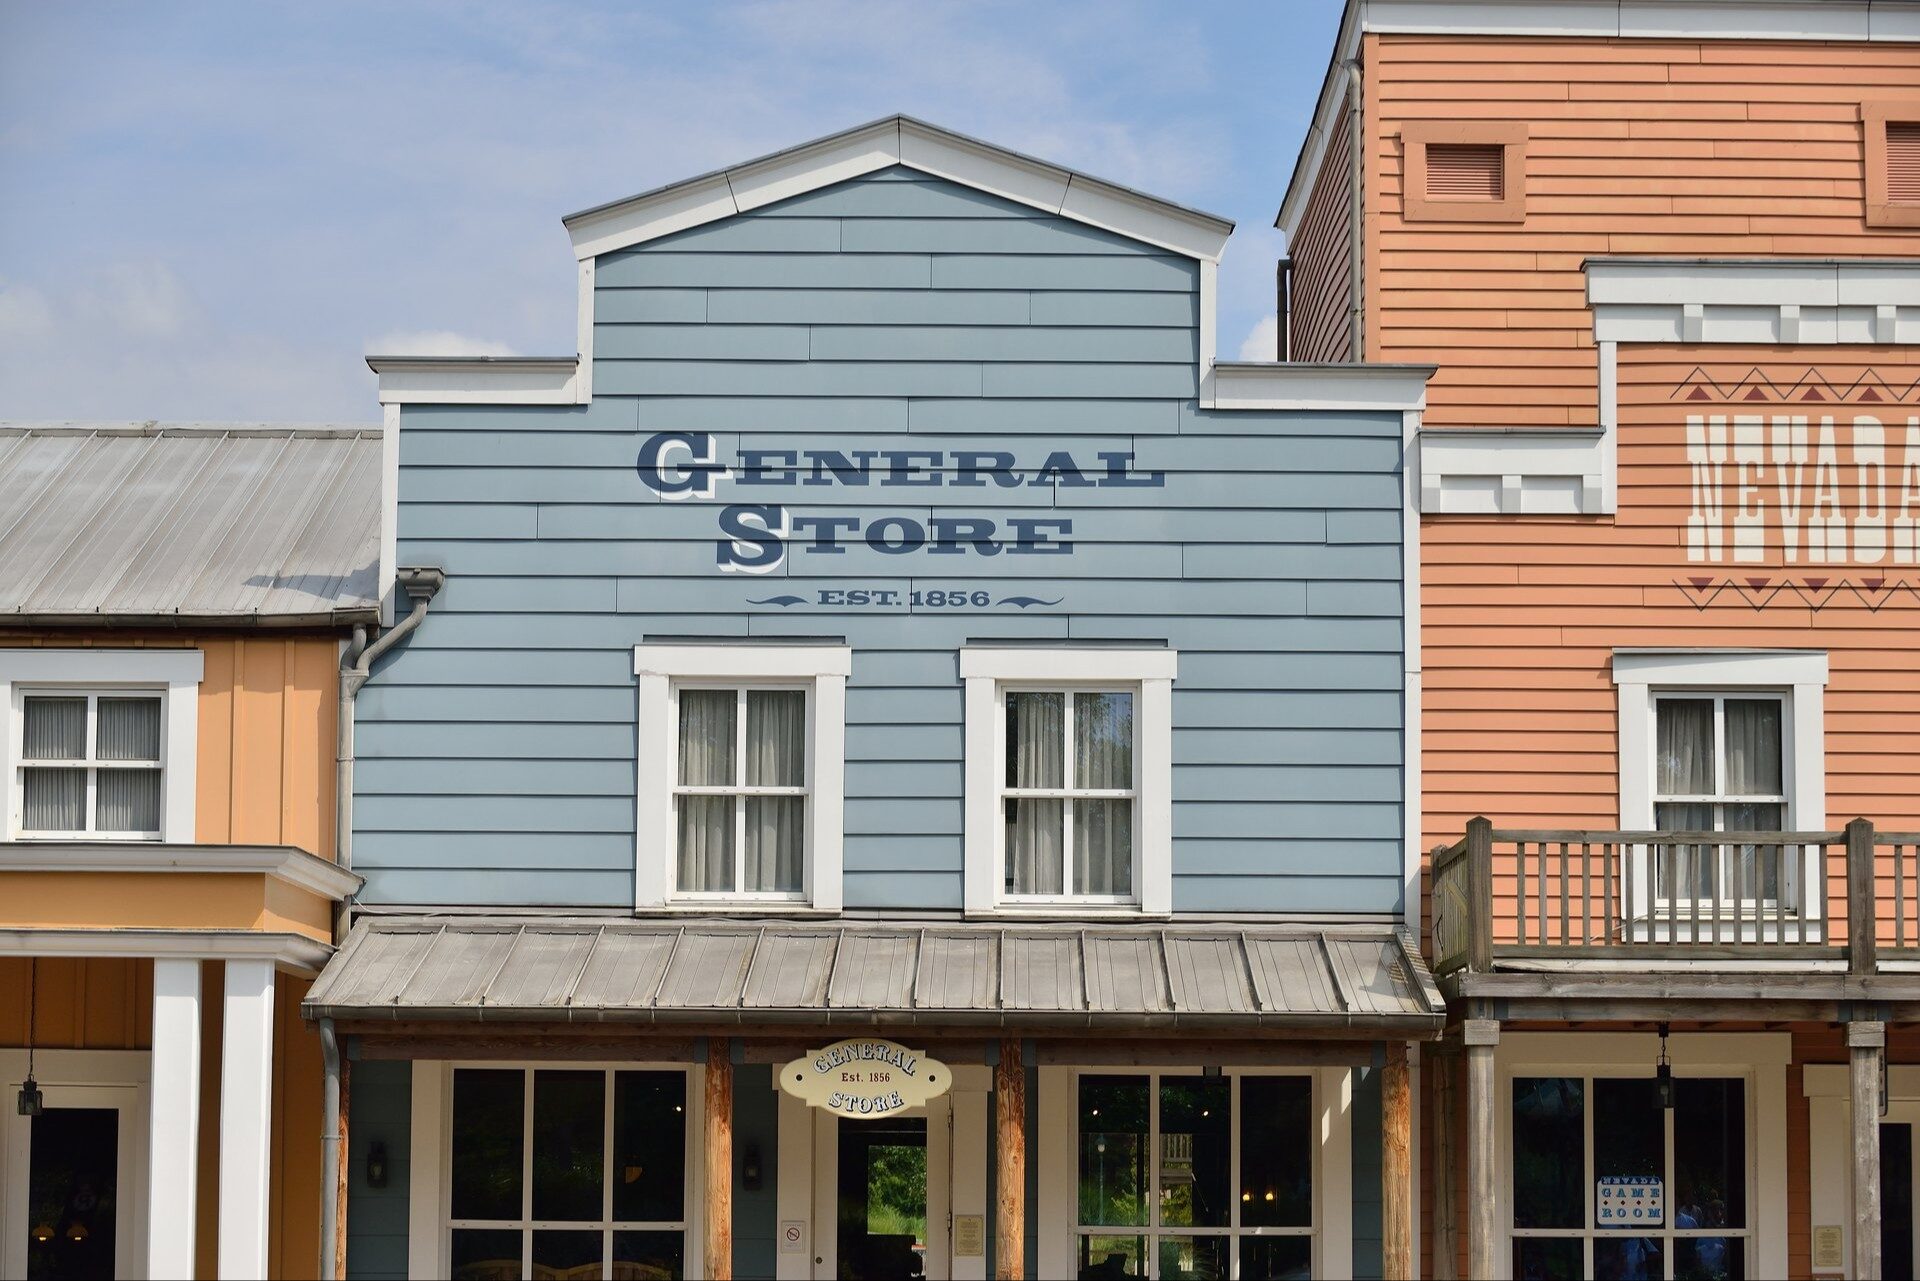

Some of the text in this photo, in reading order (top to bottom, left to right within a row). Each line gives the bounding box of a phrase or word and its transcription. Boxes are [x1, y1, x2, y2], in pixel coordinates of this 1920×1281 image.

[636, 431, 1165, 501] GENERAL
[1686, 415, 1920, 564] NEVADA
[716, 504, 1074, 575] STORE
[817, 589, 991, 607] EST. 1856
[814, 1044, 916, 1076] GENERAL
[841, 1072, 890, 1083] Est. 1856
[829, 1091, 904, 1114] STORE
[1601, 1188, 1660, 1198] GAME
[1601, 1208, 1661, 1218] ROOM
